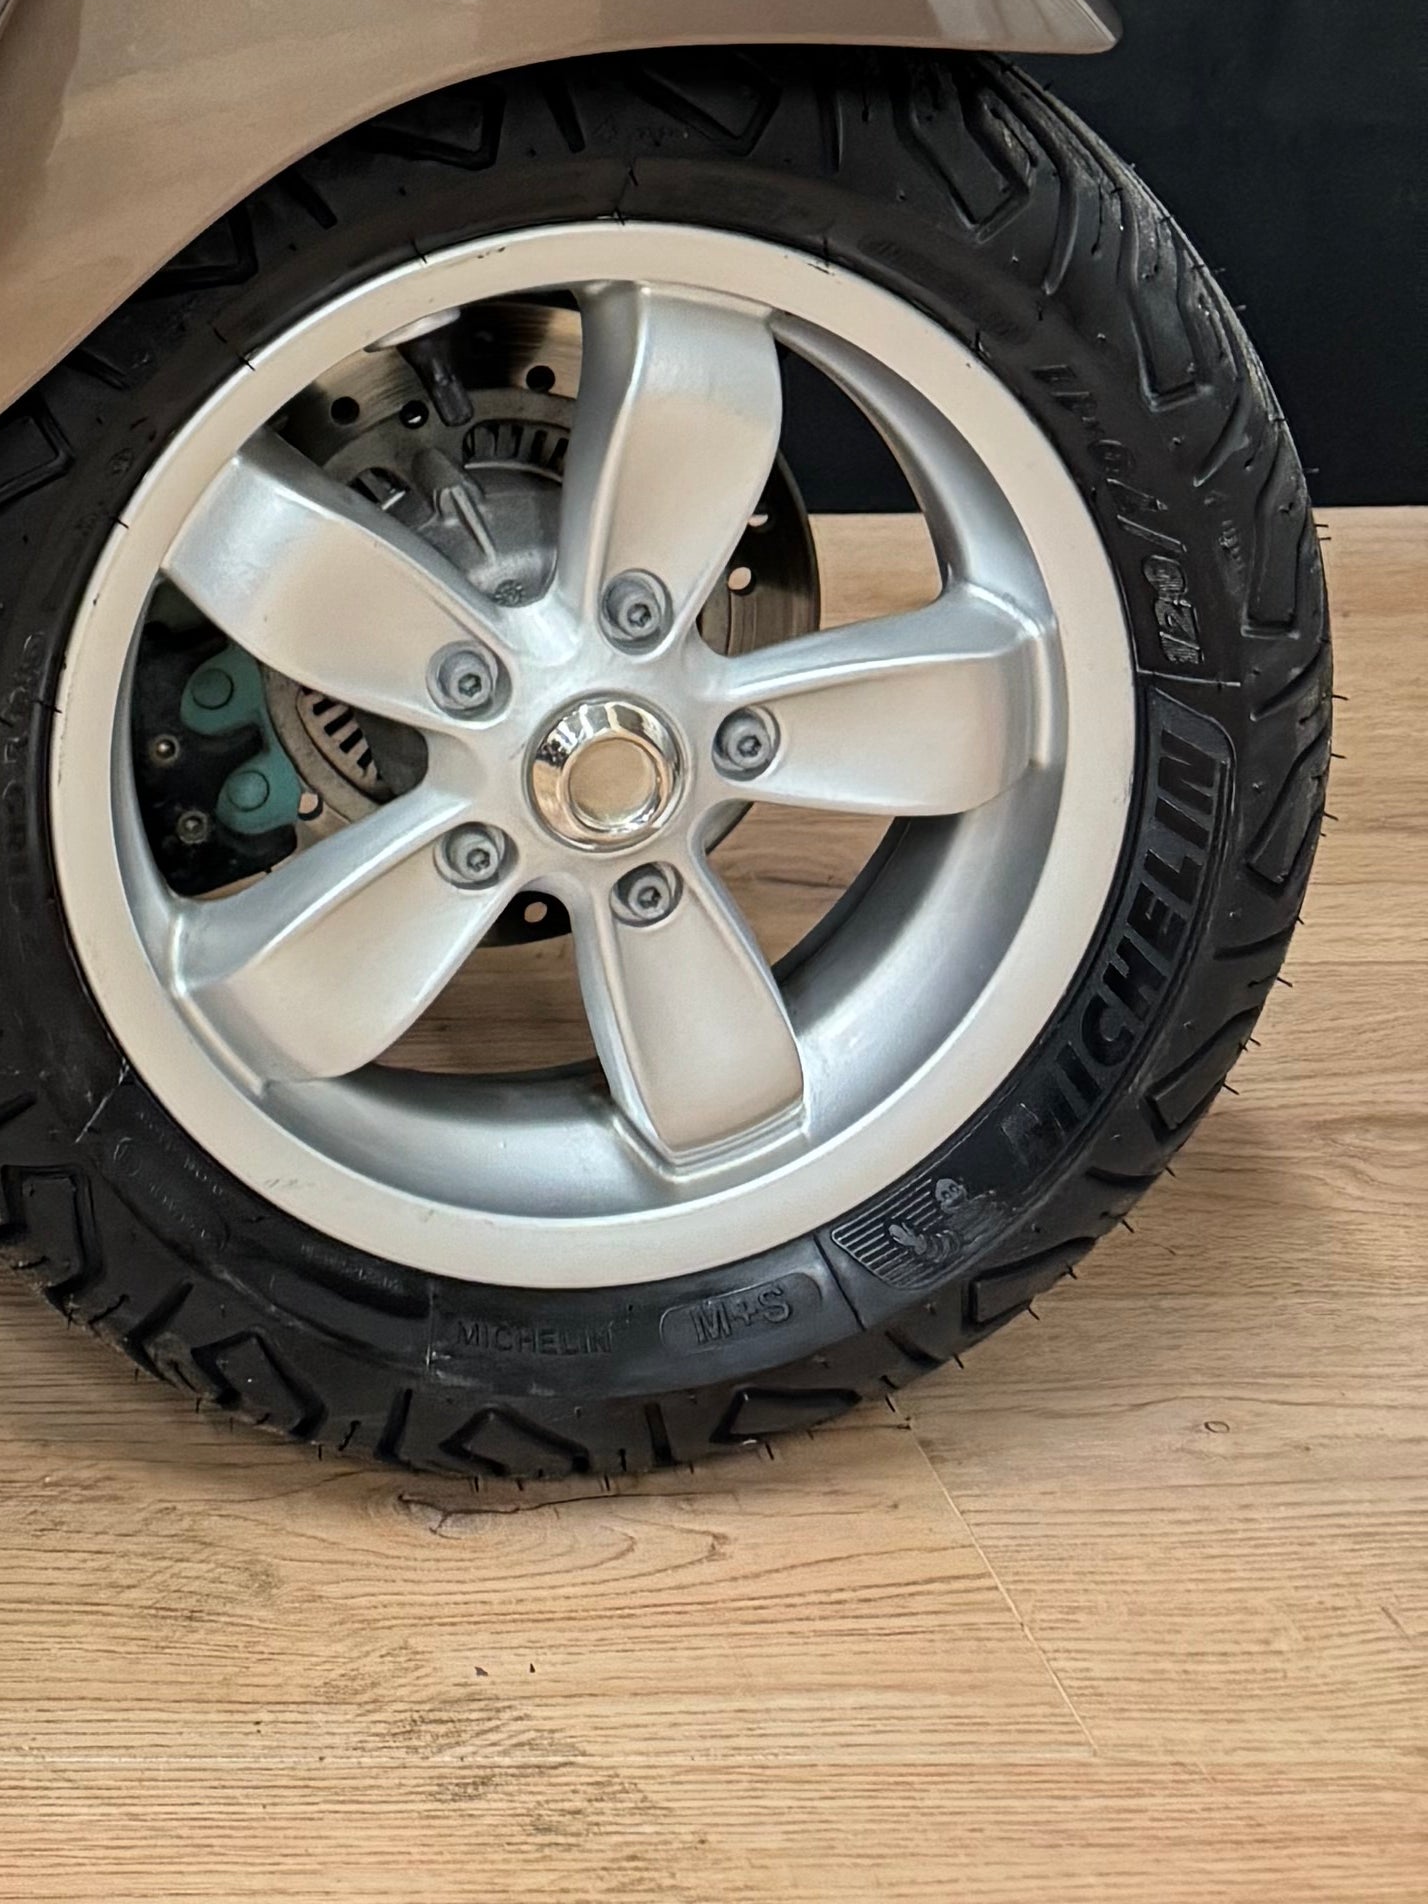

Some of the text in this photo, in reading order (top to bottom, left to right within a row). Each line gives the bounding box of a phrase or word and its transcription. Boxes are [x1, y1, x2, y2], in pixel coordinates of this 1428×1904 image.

[1000, 727, 1219, 1169] MICHELIN
[455, 1318, 616, 1356] MICHELIN
[690, 1287, 792, 1345] M+S
